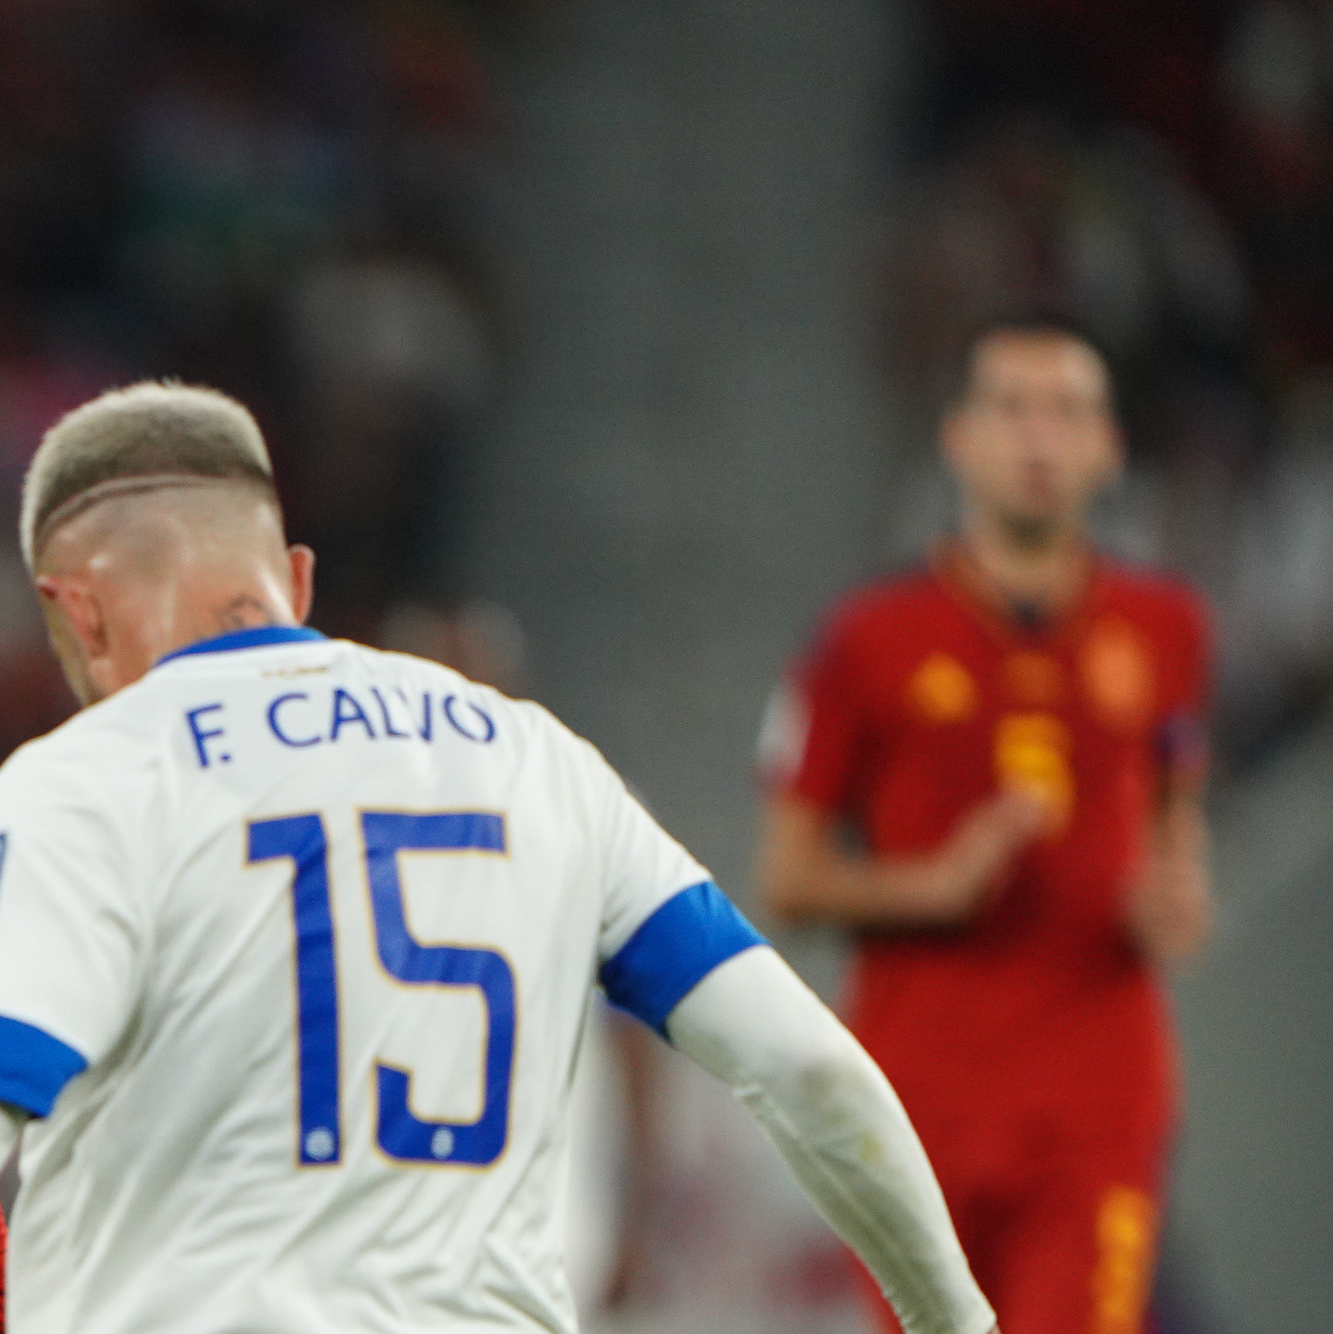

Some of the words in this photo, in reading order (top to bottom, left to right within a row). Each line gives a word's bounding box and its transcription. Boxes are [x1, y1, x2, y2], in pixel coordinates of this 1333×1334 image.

[185, 703, 232, 769] F.
[266, 685, 497, 748] CALVO
[242, 807, 519, 1173] 15
